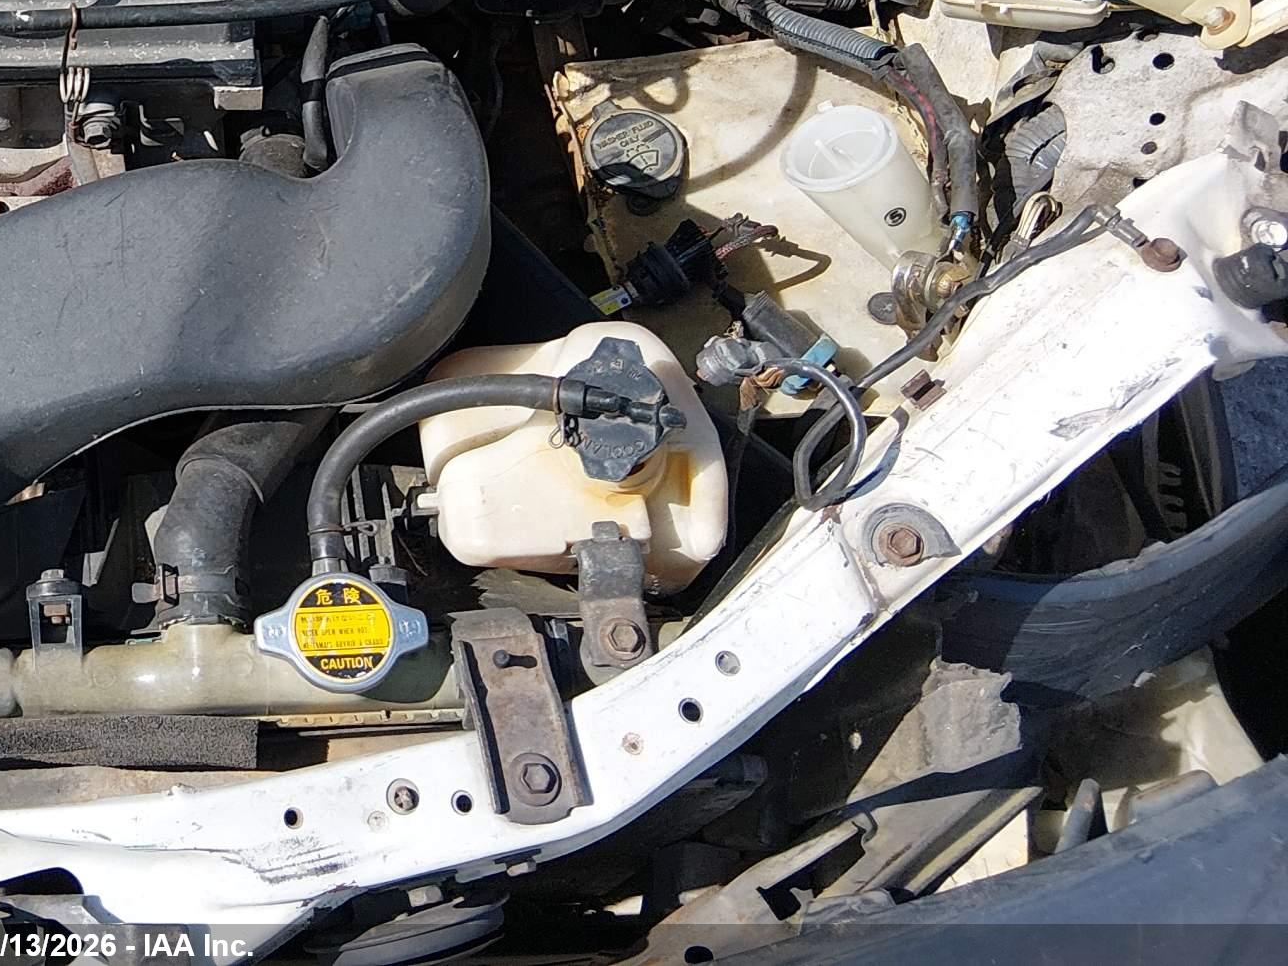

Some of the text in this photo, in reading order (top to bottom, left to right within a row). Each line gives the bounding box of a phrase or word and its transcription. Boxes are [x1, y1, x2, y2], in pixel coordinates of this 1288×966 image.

[631, 119, 655, 135] FLUID
[314, 587, 363, 606] 危険
[320, 655, 374, 671] CAUTION
